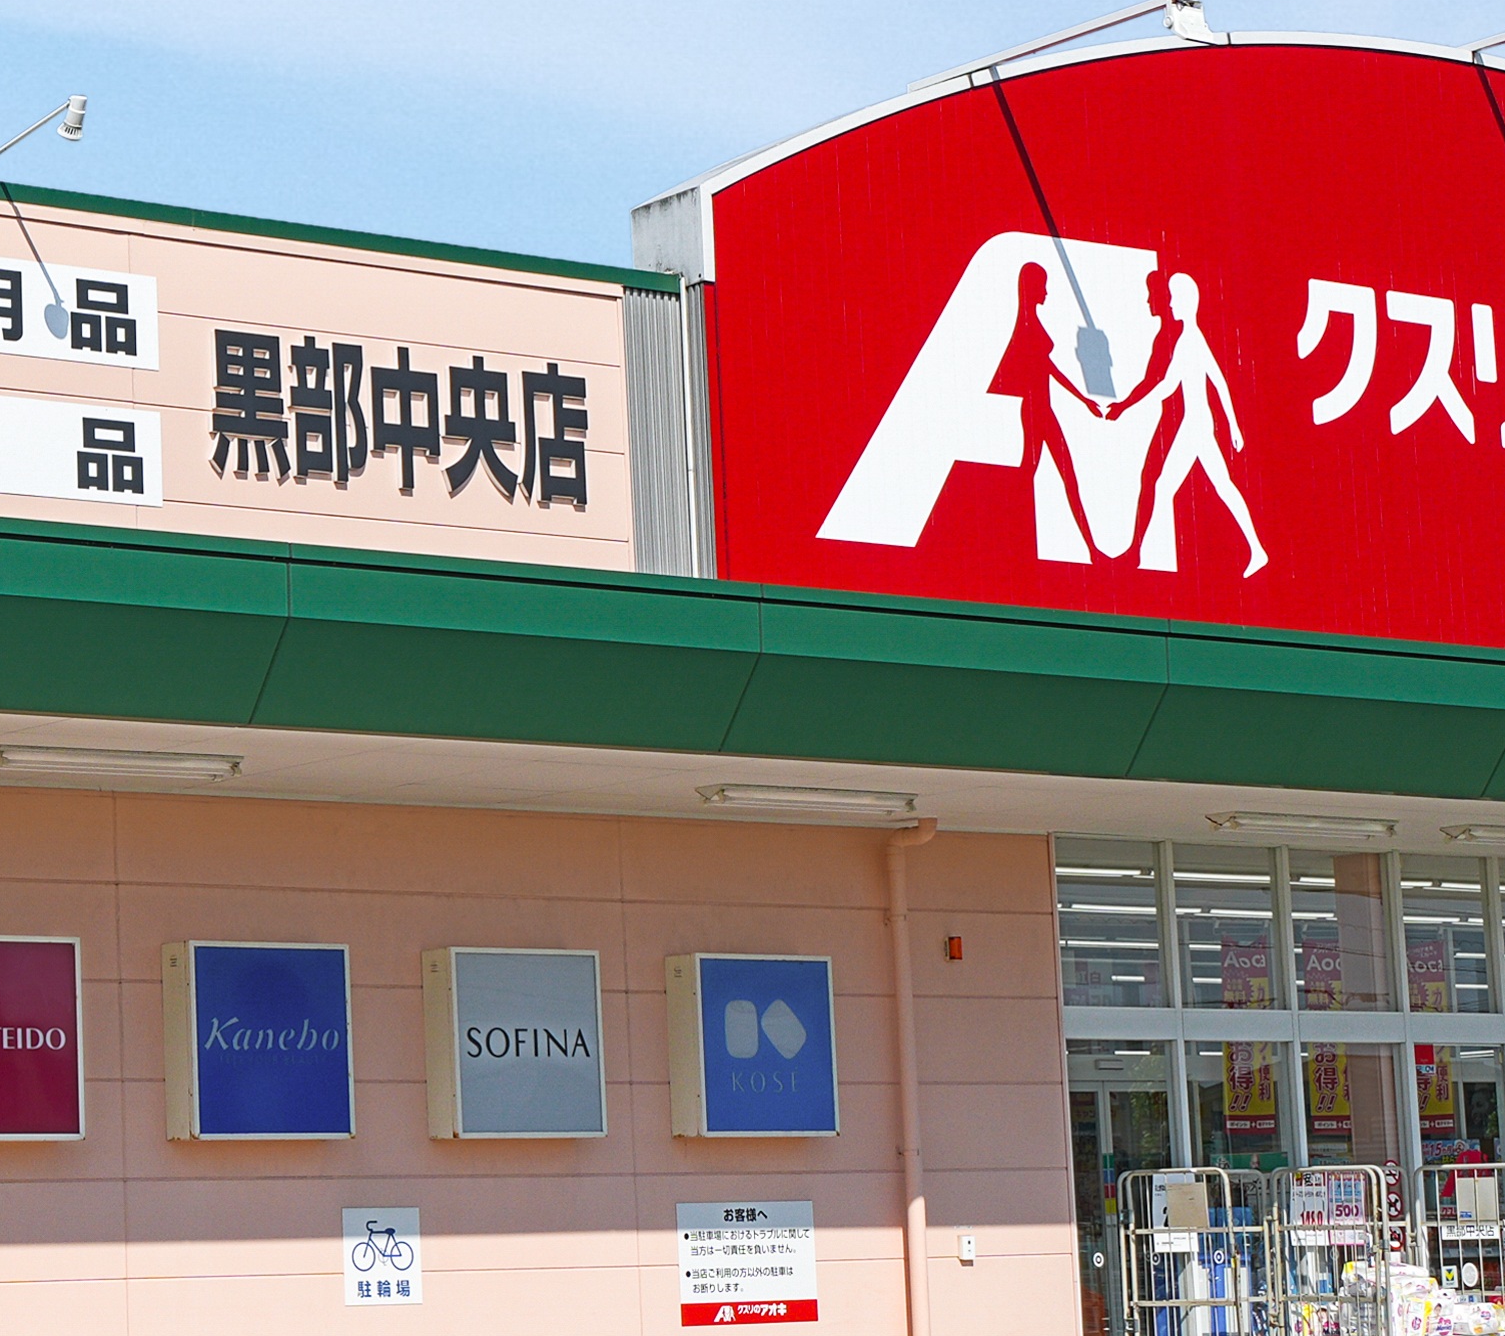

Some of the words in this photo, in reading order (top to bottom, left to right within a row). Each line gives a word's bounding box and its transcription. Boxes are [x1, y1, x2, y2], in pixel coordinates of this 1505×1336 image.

[208, 328, 590, 507] 黒部中央店
[203, 1016, 340, 1051] Kanebo
[466, 1027, 591, 1058] SOFINA
[723, 1208, 768, 1222] お客様へ
[357, 1280, 411, 1298] 駐輪場
[737, 1303, 787, 1317] クスリのアオキ
